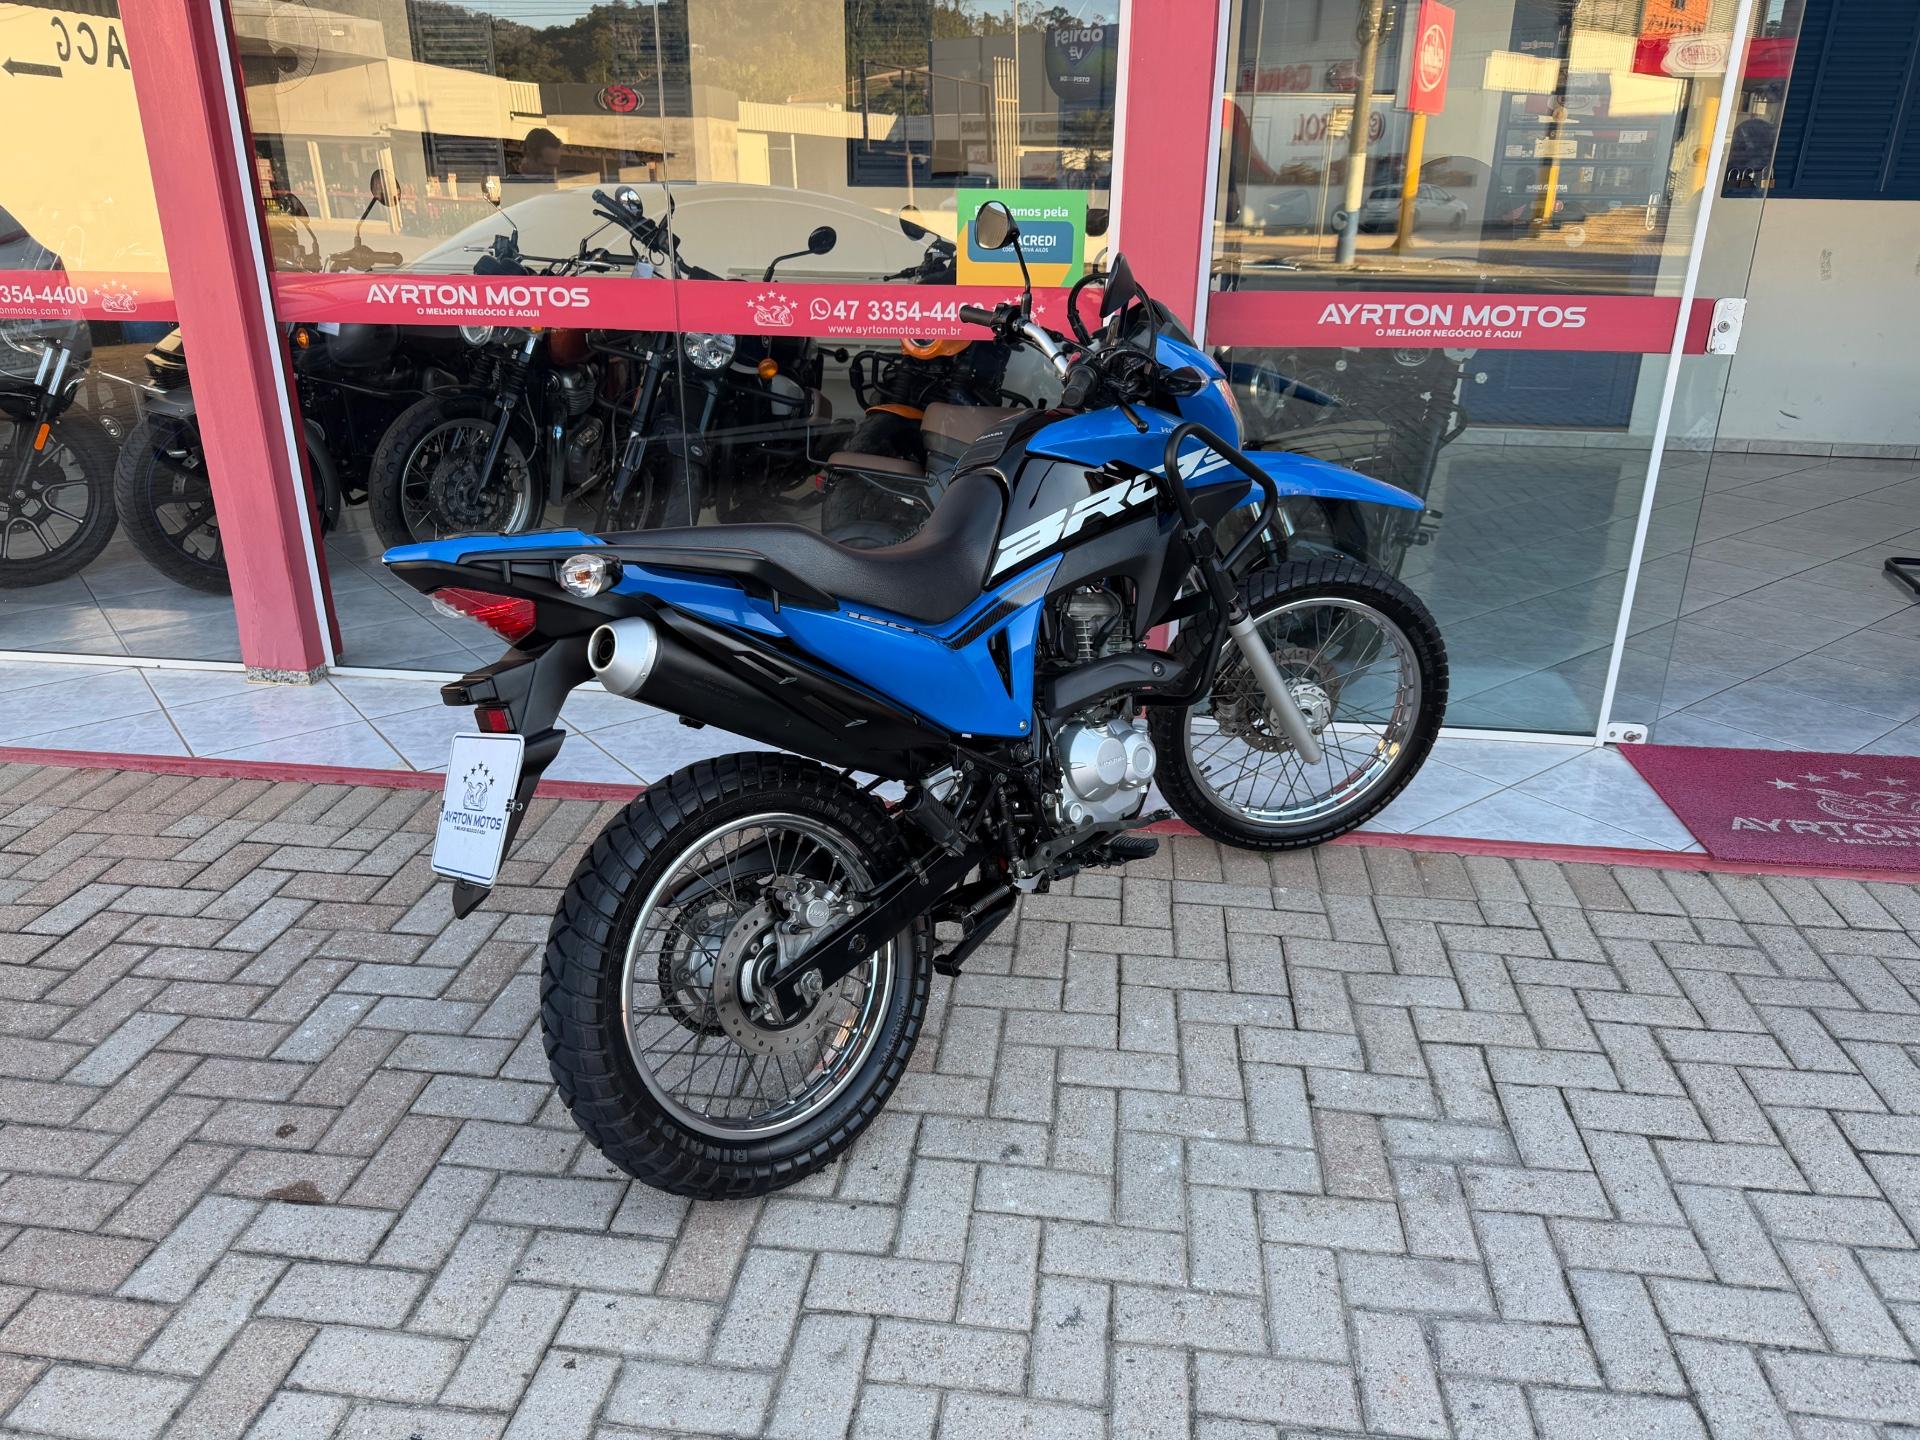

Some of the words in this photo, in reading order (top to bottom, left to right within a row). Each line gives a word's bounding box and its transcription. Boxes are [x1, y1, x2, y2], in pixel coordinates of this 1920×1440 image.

[1044, 206, 1069, 218] pela
[1010, 235, 1057, 247] ACREDI
[366, 284, 478, 305] AYRTON
[486, 286, 590, 308] MOTOS
[416, 307, 425, 315] O
[426, 308, 463, 316] MELHOR
[465, 307, 507, 317] NEGÓCIO
[508, 307, 514, 317] É
[516, 309, 540, 318] AQUI
[833, 300, 859, 320] 47
[1317, 303, 1454, 326] AYRTON
[1462, 305, 1588, 328] MOTOS
[828, 324, 961, 336] www.ayrtonmotos.com.br
[1375, 329, 1385, 337] O
[1386, 329, 1431, 337] MELHOR
[1432, 327, 1483, 338] NEGÓCIO
[1484, 327, 1492, 338] É
[1492, 330, 1522, 339] AQUI
[444, 810, 473, 826] AYRTON
[473, 813, 502, 831] MOTOS
